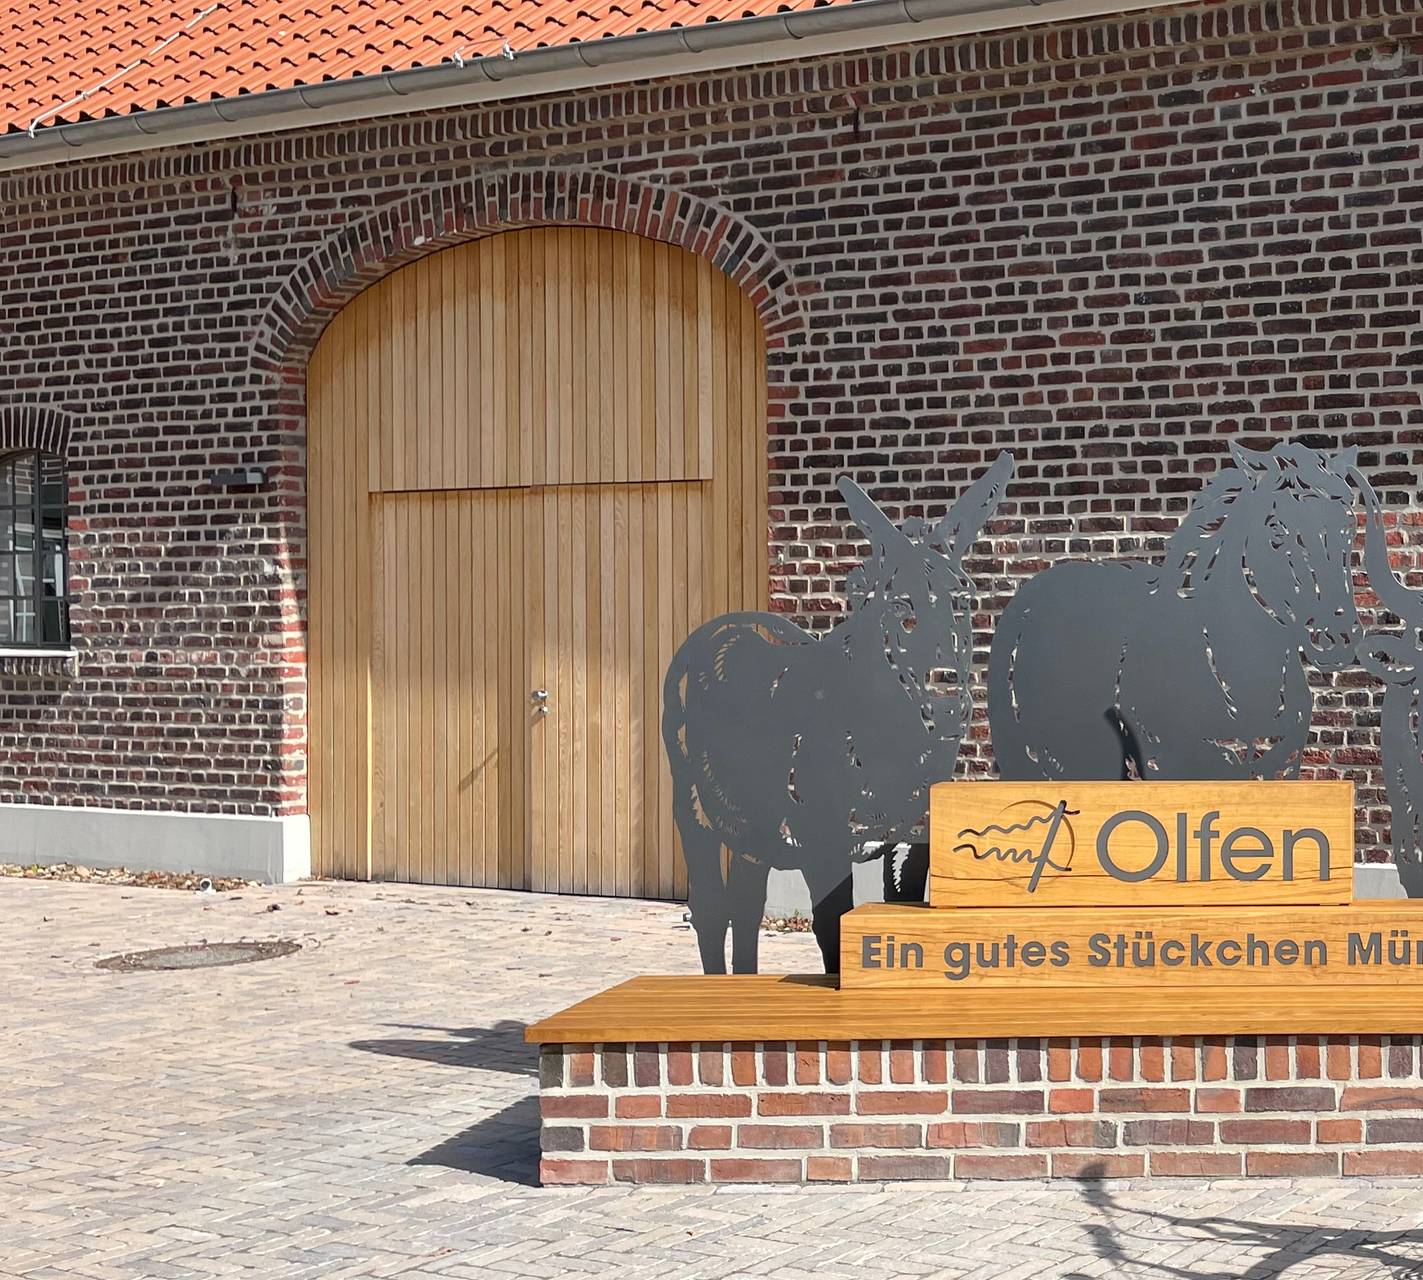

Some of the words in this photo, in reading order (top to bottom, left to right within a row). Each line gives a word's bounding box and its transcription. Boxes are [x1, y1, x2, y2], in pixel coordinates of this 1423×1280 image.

[1096, 811, 1330, 883] Olfen
[863, 936, 923, 968] Ein
[944, 936, 1069, 980] gutes
[1088, 933, 1327, 967] Stückchen
